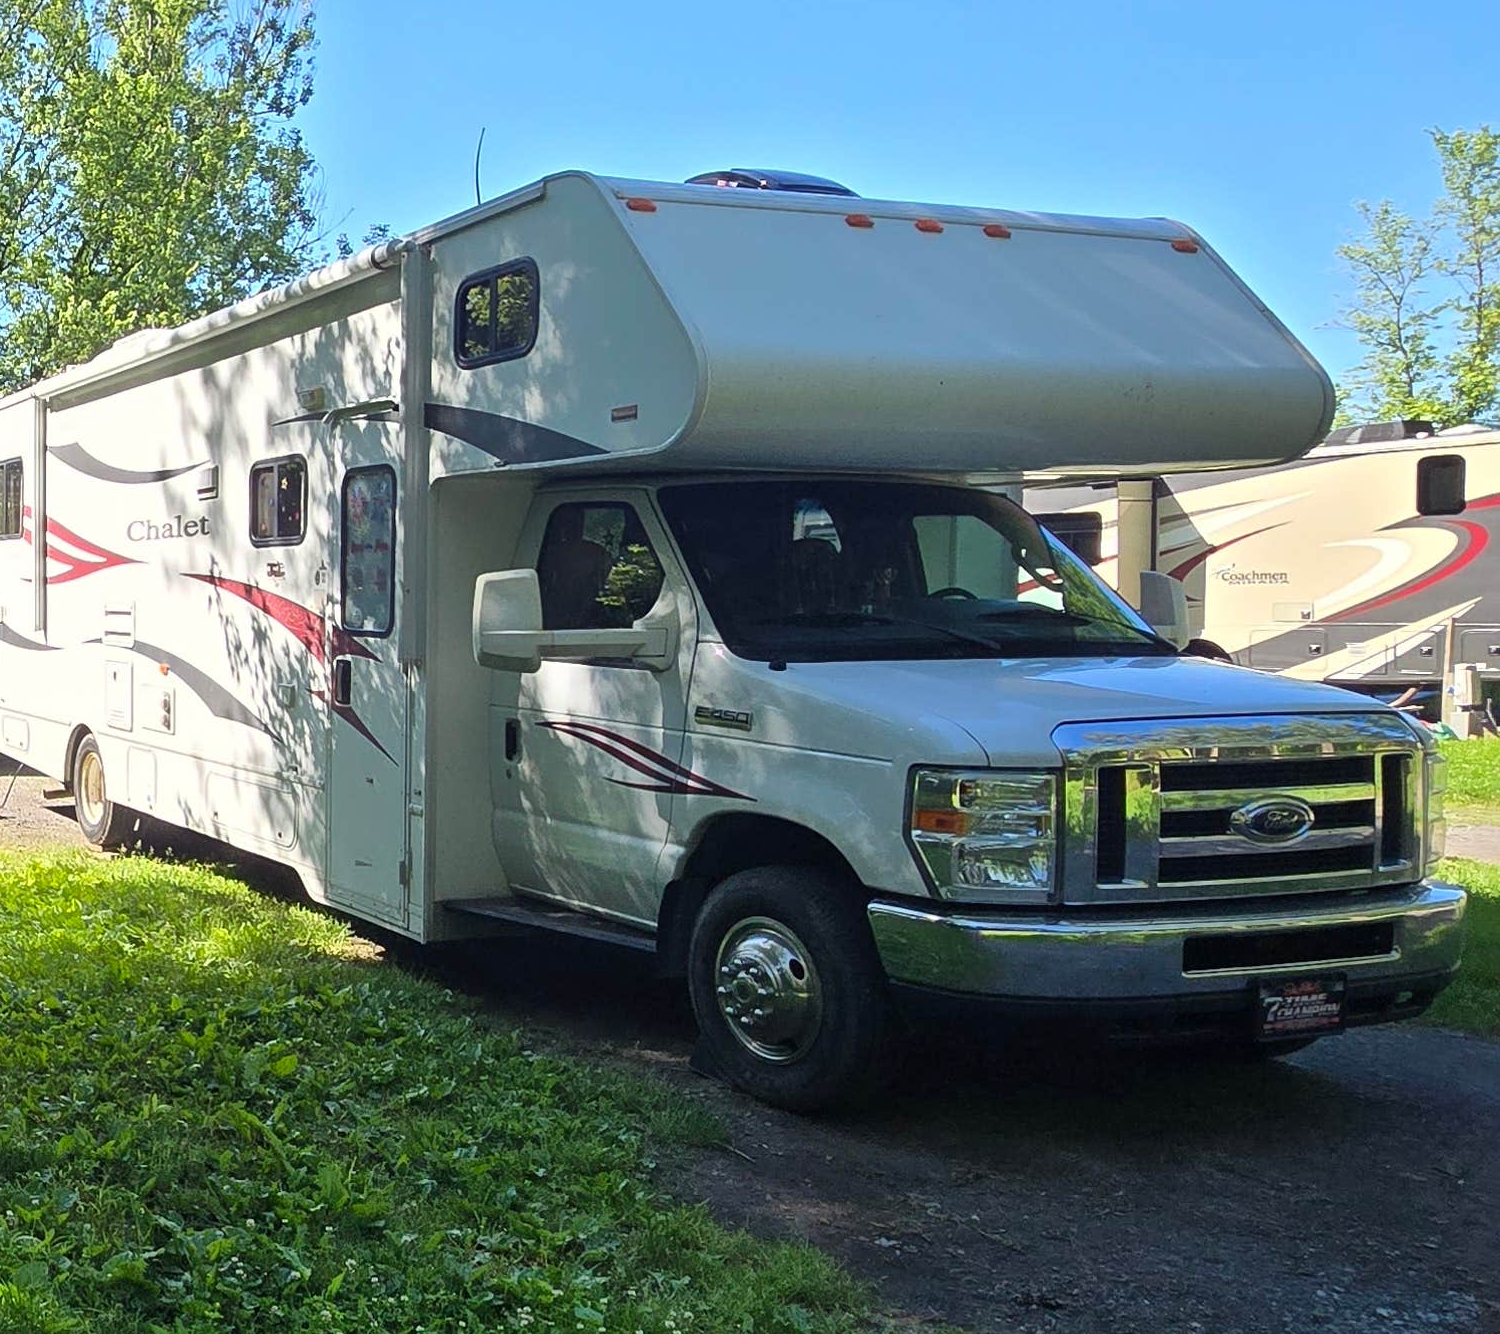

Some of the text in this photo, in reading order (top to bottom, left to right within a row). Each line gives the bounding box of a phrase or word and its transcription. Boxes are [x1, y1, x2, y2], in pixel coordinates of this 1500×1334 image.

[126, 514, 211, 542] Chalet
[1221, 570, 1288, 582] Coachmen
[1265, 810, 1299, 828] Ford
[1263, 996, 1284, 1022] 7
